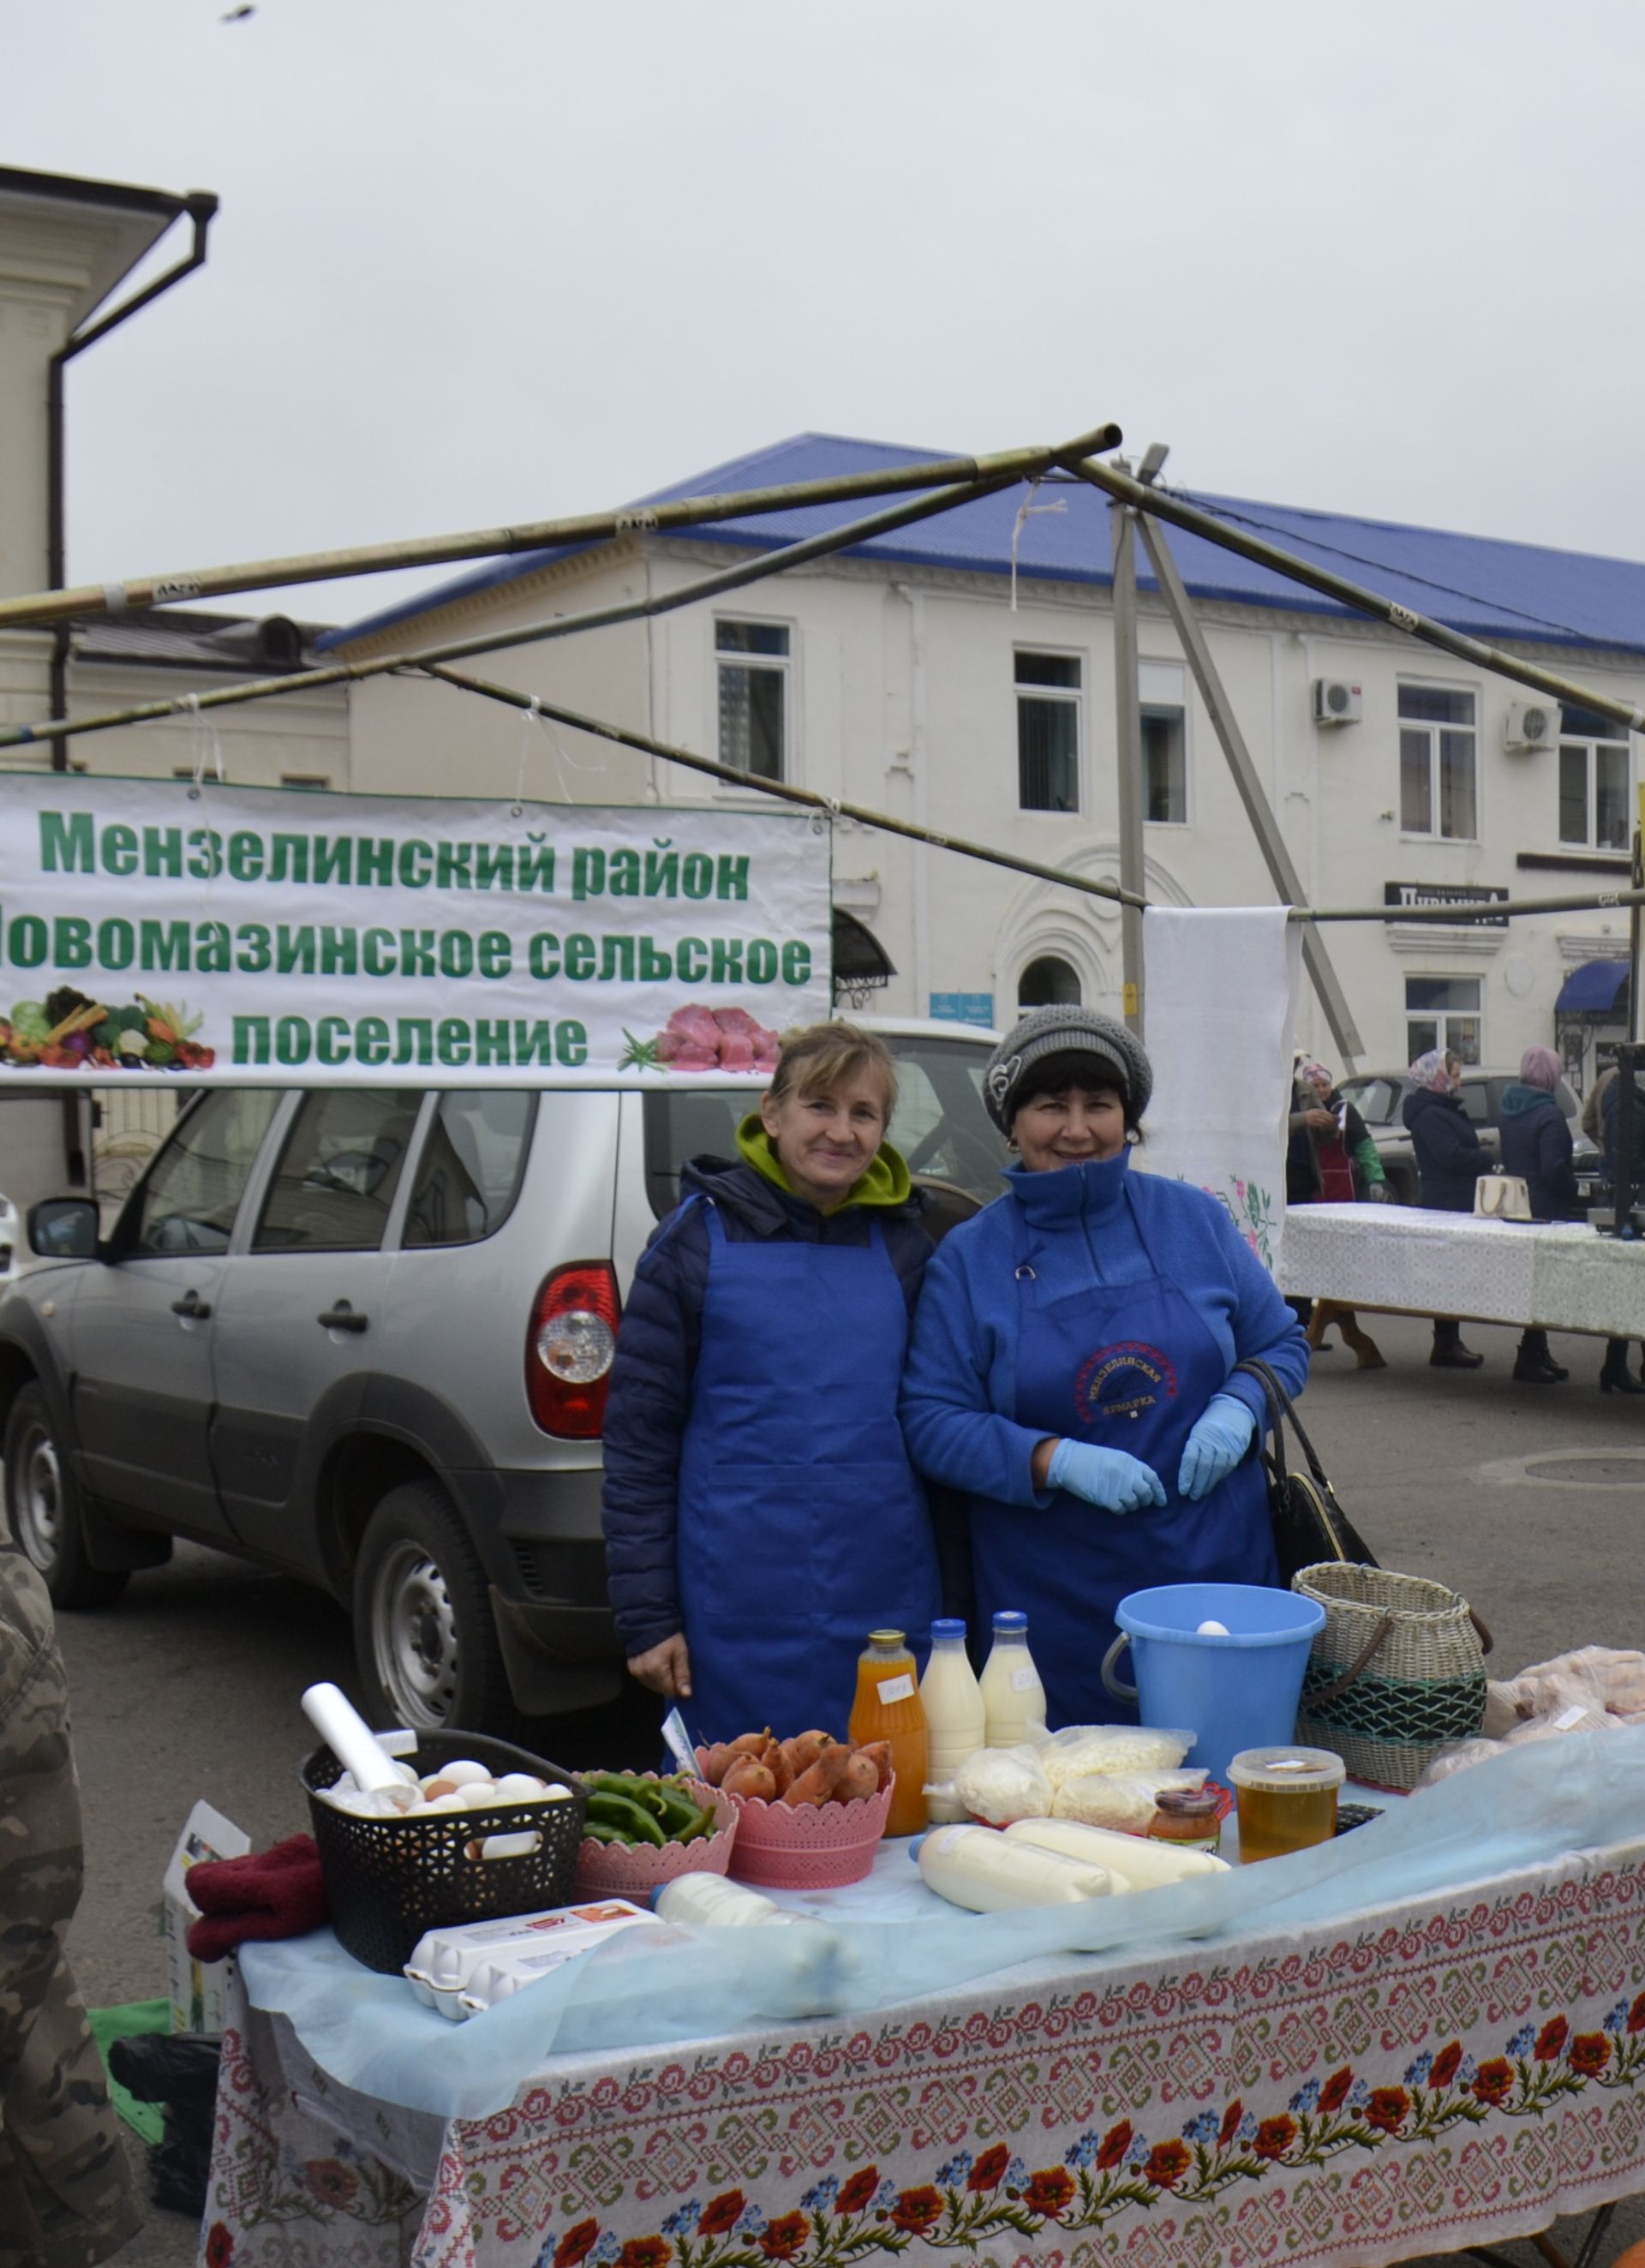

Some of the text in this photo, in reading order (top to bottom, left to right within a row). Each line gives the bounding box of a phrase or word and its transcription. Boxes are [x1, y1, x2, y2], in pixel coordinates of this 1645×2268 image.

[39, 811, 751, 901] Мензелинский район
[0, 906, 812, 986] овомазинское сельское
[232, 1015, 589, 1068] поселение
